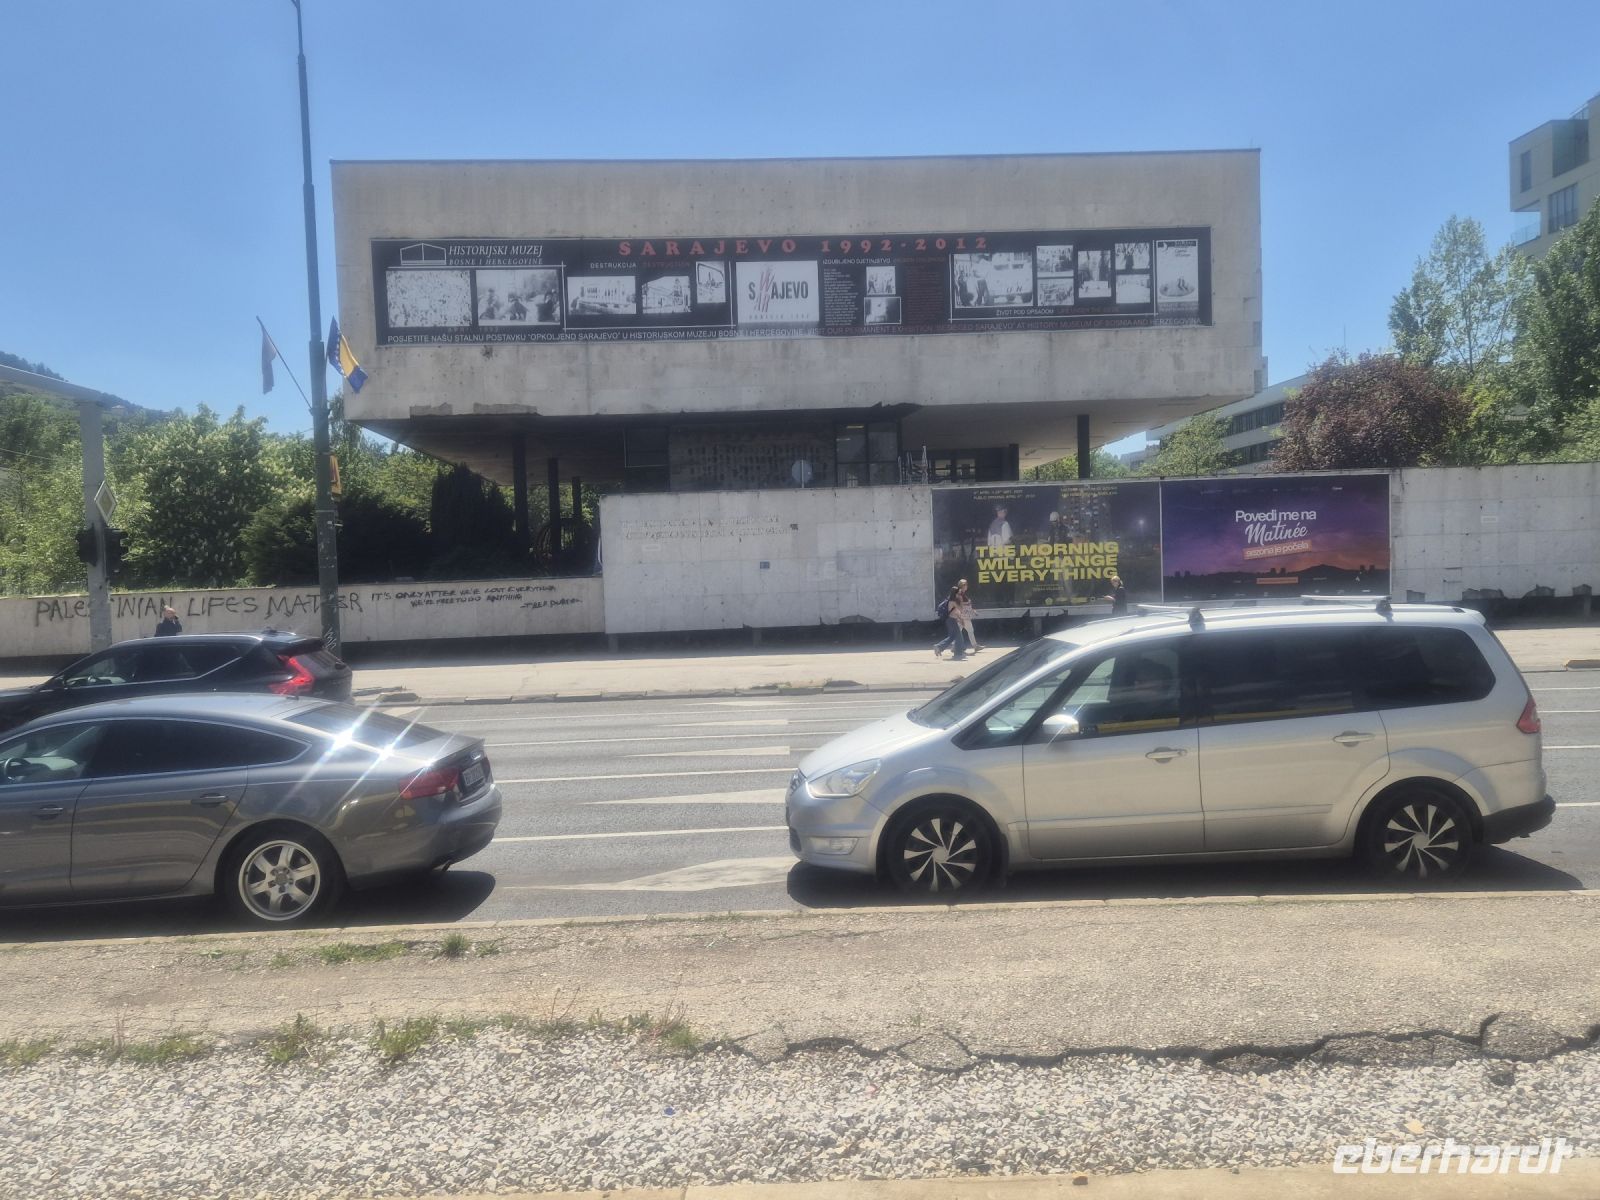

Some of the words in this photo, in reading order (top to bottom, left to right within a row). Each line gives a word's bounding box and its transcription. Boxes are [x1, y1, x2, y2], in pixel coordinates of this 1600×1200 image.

[449, 245, 507, 257] HISTORIJSKI
[509, 245, 543, 257] MUZEJ
[619, 239, 797, 256] SARAJEVO
[388, 335, 429, 343] POSJETITE
[431, 334, 452, 342] NAŠU
[455, 334, 483, 342] STALNU
[486, 333, 525, 341] POSTAVKU
[630, 331, 684, 339] HISTORIJSKOM
[687, 330, 716, 338] MUZEJU
[1235, 509, 1276, 523] Povedi
[1279, 511, 1300, 520] me
[1301, 510, 1317, 520] na
[1245, 521, 1308, 546] Matinée
[976, 545, 1015, 558] THE
[1020, 541, 1119, 556] MORNING
[978, 557, 1027, 570] WILL
[1031, 554, 1118, 569] CHANGE
[978, 566, 1119, 583] EVERYTHING
[371, 592, 391, 601] IT'S
[35, 597, 172, 627] PALEINIAN
[187, 596, 265, 617] LIFES
[265, 592, 363, 619] MATER
